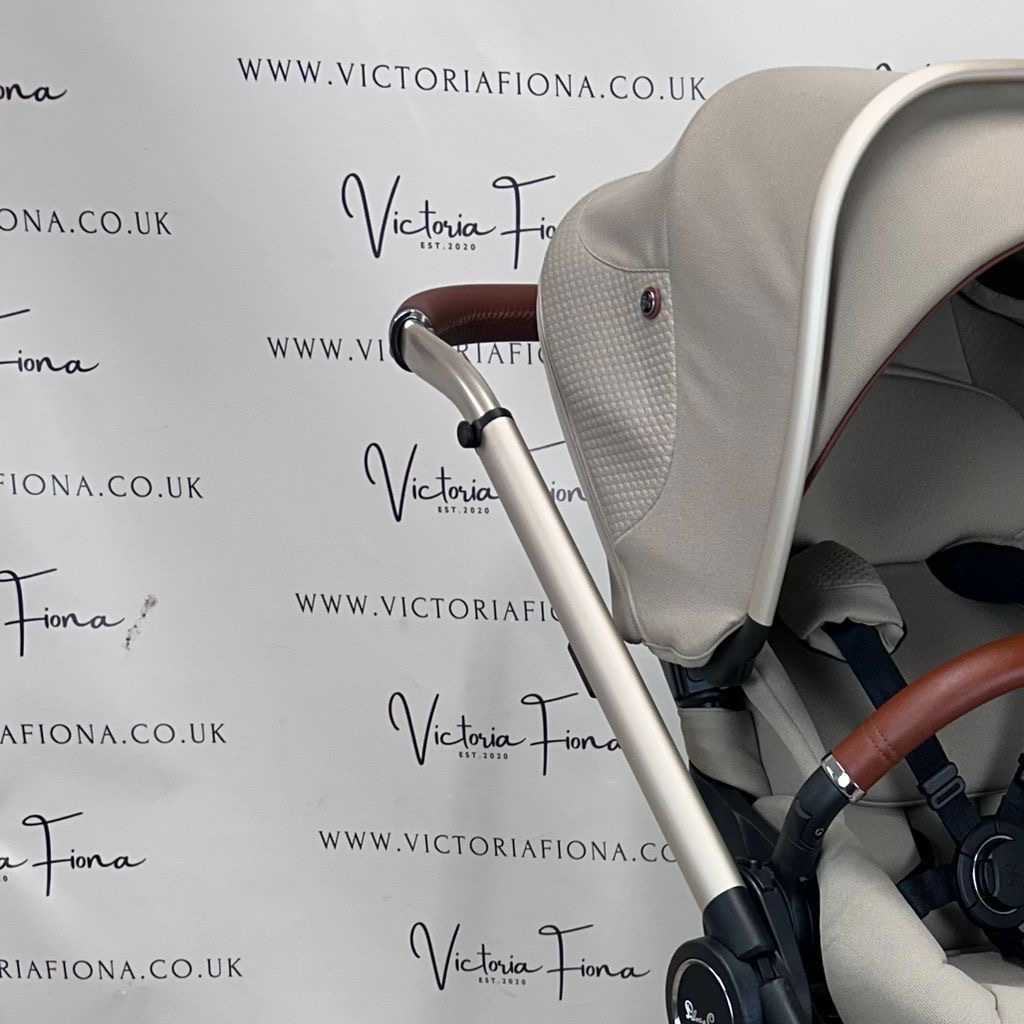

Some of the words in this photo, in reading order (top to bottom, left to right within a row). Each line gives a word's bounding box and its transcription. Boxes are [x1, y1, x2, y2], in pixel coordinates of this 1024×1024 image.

[238, 58, 705, 100] WWW.VICTORIAFIONA.CO.UK
[340, 172, 497, 260] Victoria
[420, 241, 476, 251] EST.2020
[363, 441, 500, 523] Victoria
[437, 505, 490, 515] EST.2020
[387, 691, 526, 766] Victoria
[458, 751, 509, 760] EST.2020
[22, 811, 147, 898] Fiona
[409, 921, 544, 991] Victoria
[537, 923, 652, 1001] Fiona
[478, 976, 527, 986] EST.2020
